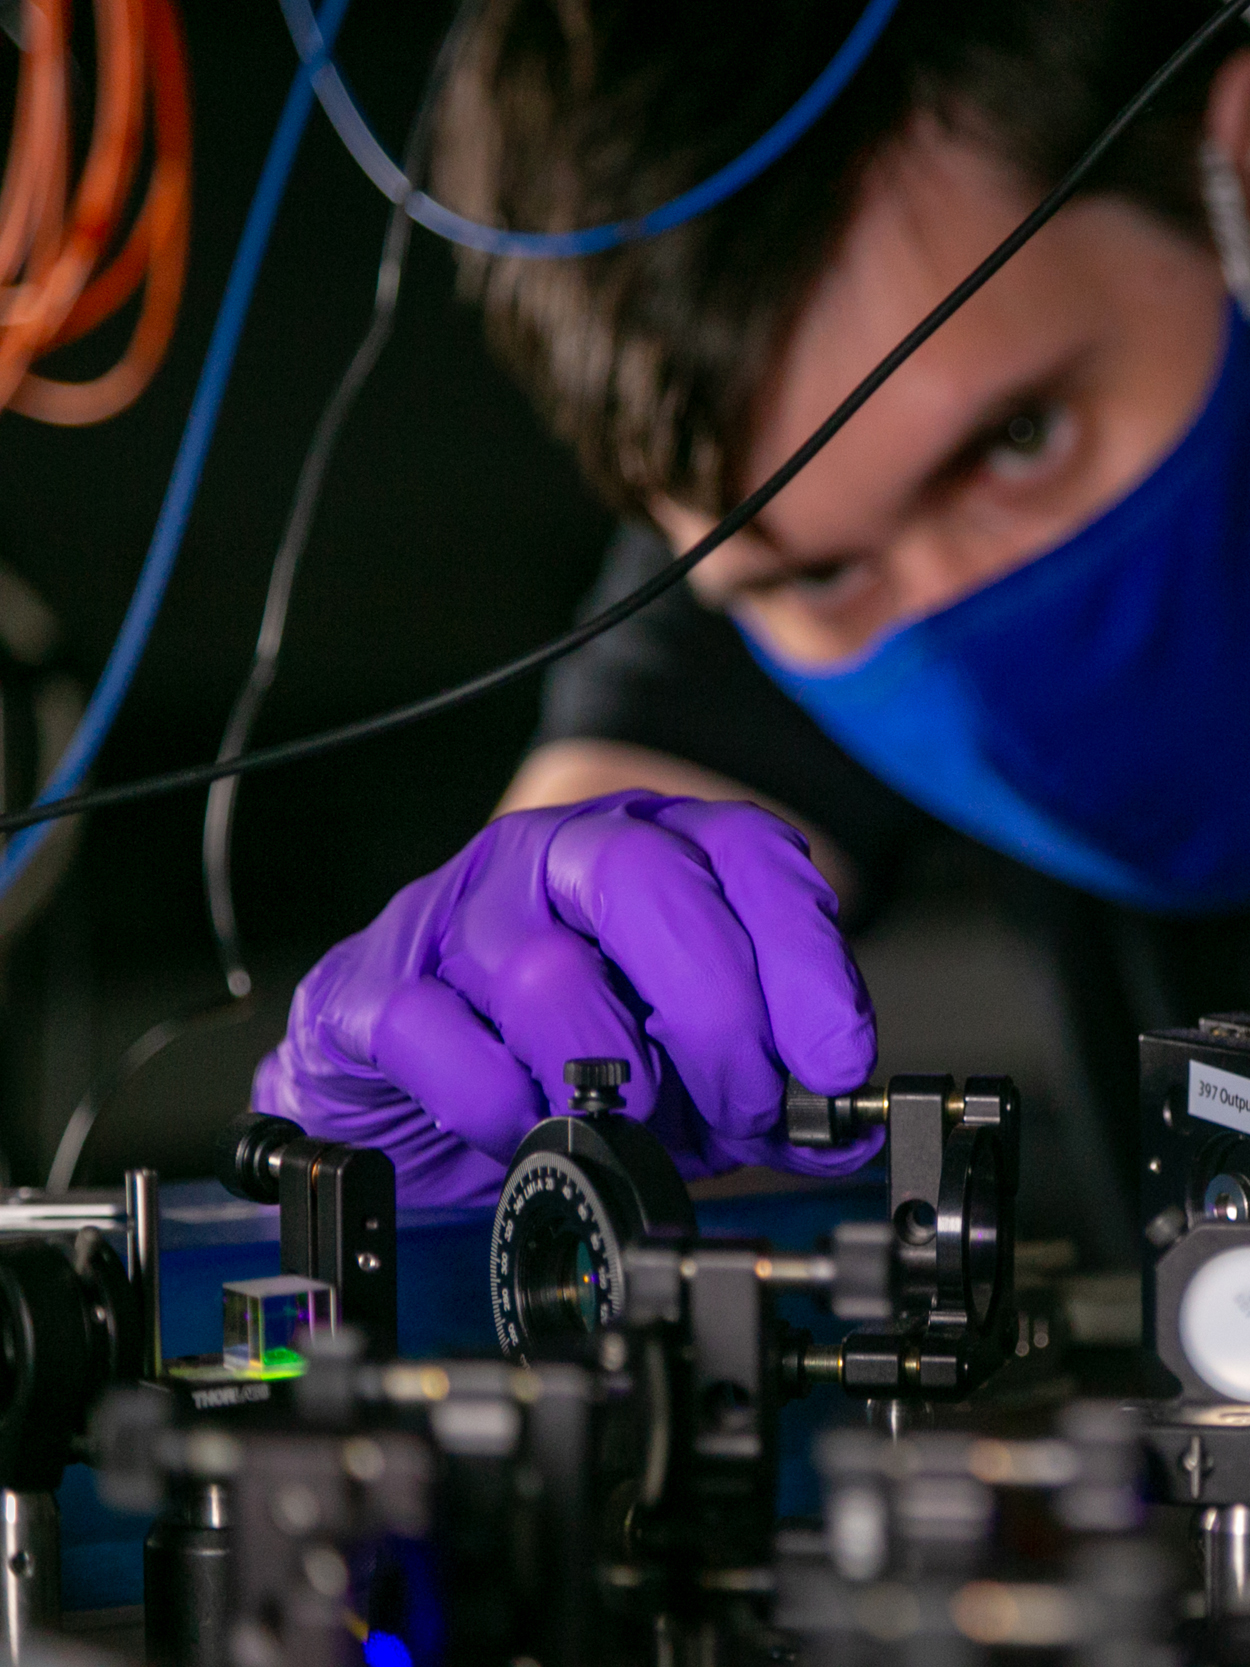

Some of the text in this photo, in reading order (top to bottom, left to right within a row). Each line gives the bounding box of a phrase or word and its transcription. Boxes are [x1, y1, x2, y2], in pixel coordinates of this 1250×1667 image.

[1198, 1080, 1218, 1101] 397
[545, 1177, 555, 1191] 20
[504, 1219, 514, 1243] 320
[501, 1251, 509, 1276] 300
